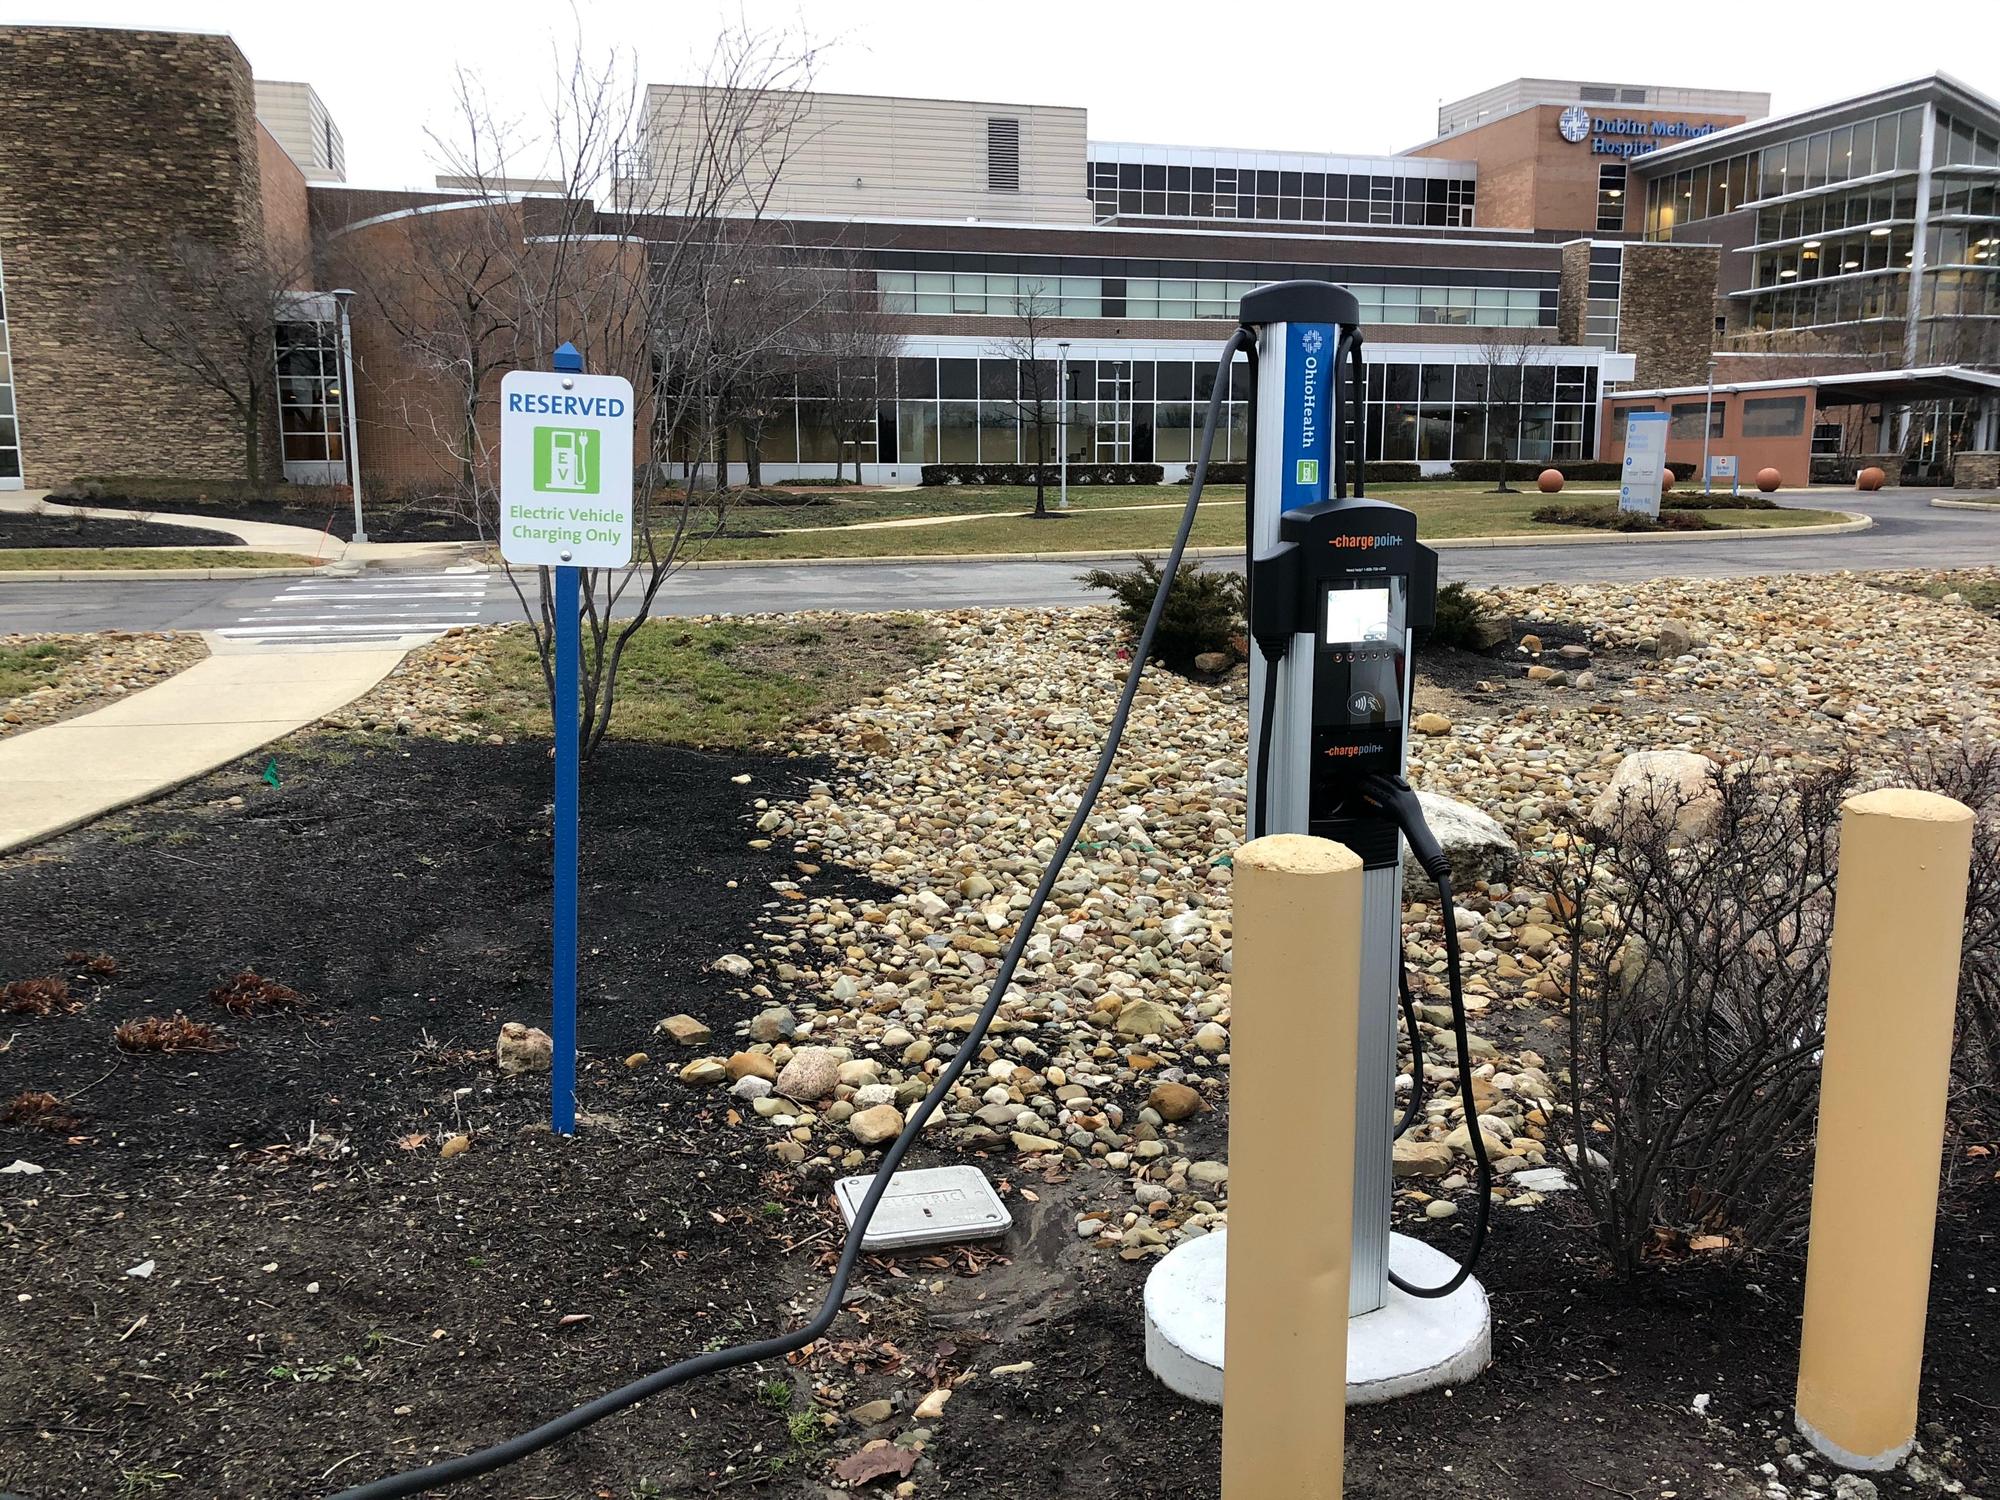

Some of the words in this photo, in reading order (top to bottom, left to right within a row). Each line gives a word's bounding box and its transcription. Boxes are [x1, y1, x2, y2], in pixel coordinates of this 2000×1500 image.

[1593, 117, 1647, 135] Dublin
[1592, 138, 1661, 159] Hospital
[510, 393, 624, 417] RESERVED
[1302, 356, 1318, 448] OhioHealth
[510, 505, 564, 520] Electric
[568, 508, 624, 523] Vehicle
[512, 525, 582, 544] Charging
[585, 528, 621, 546] Only
[884, 1192, 961, 1208] ELECTRIC
